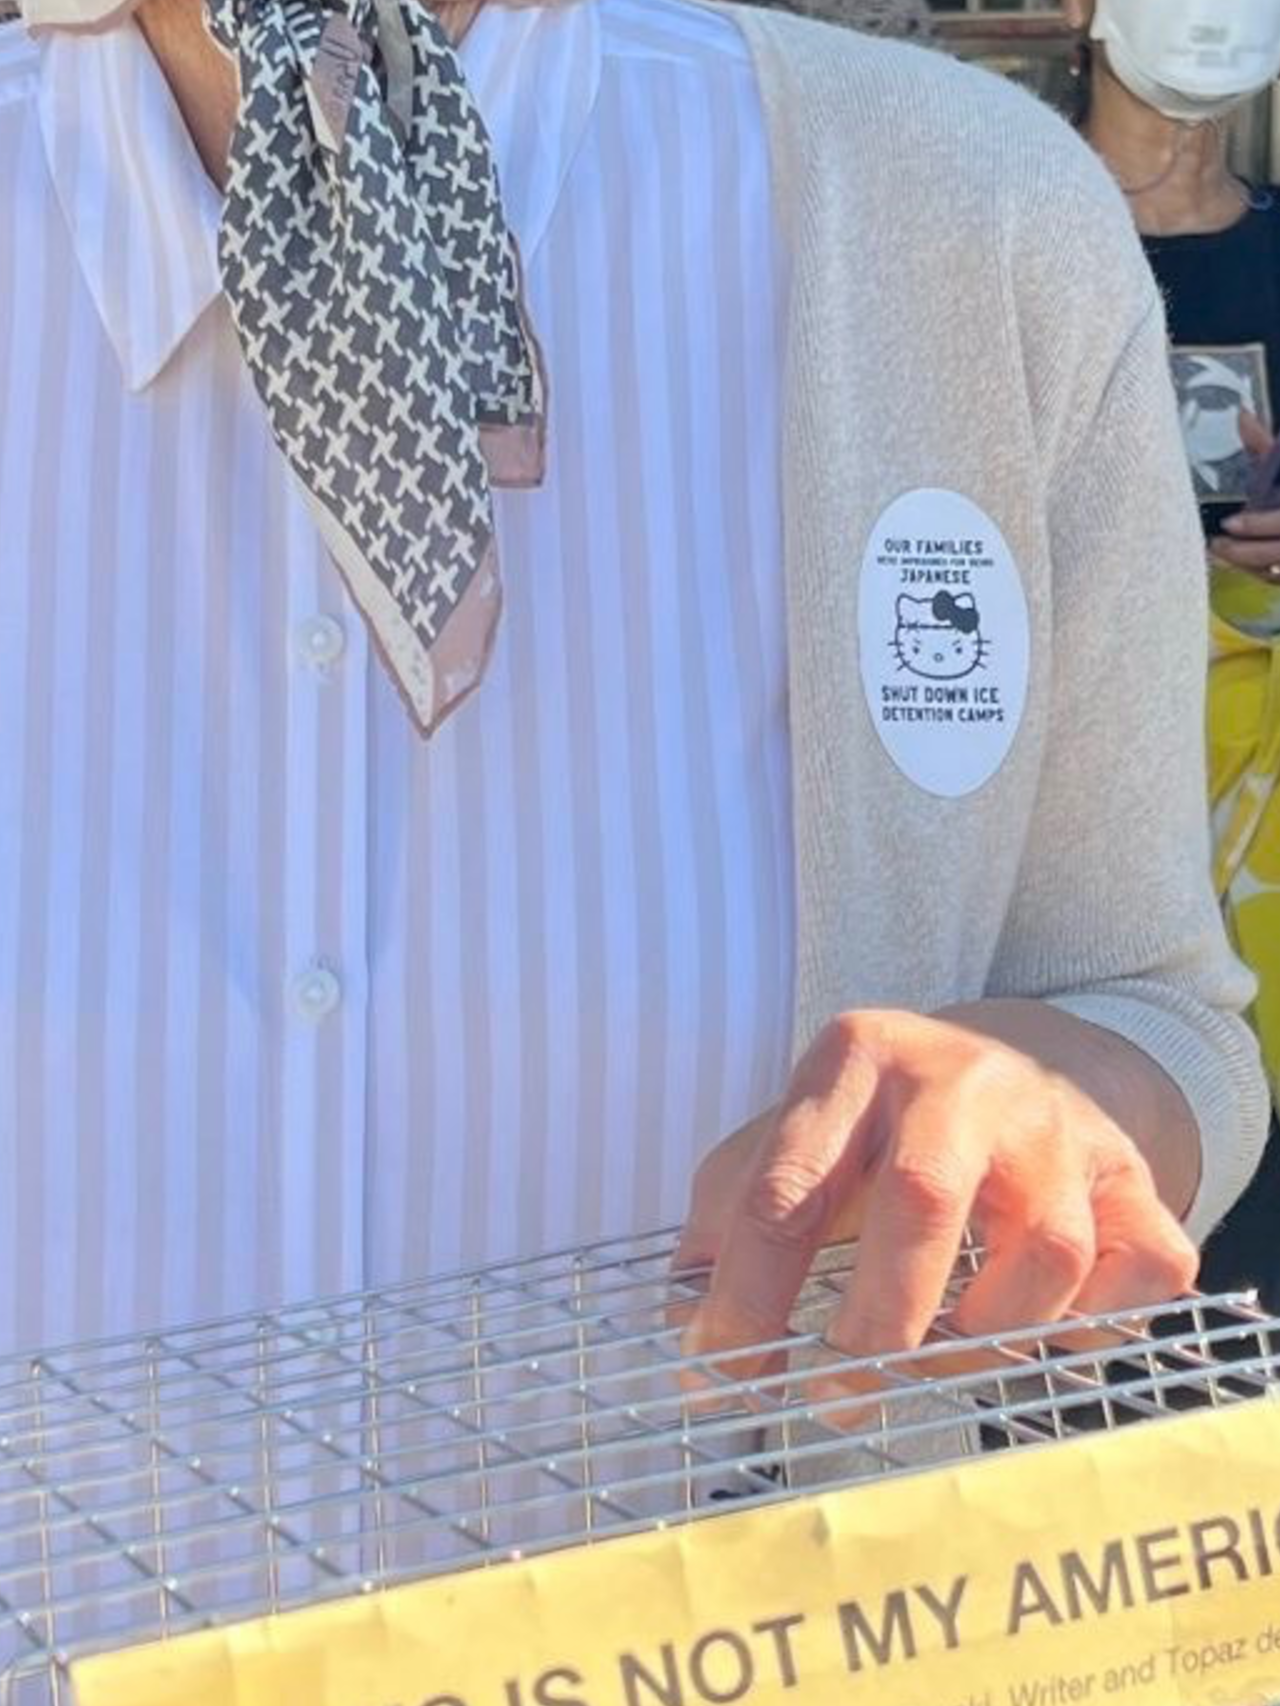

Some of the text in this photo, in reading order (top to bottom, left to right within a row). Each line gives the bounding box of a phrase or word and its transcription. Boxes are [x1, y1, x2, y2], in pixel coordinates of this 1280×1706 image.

[883, 538, 984, 556] OUR FAMILIES
[900, 568, 971, 585] JAPANESE
[881, 685, 1000, 704] SHUT DOWN ICE
[881, 706, 1004, 723] DETENTION CAMPS
[836, 1574, 969, 1673] MY
[1102, 1654, 1157, 1694] and
[1164, 1637, 1249, 1677] Topaz
